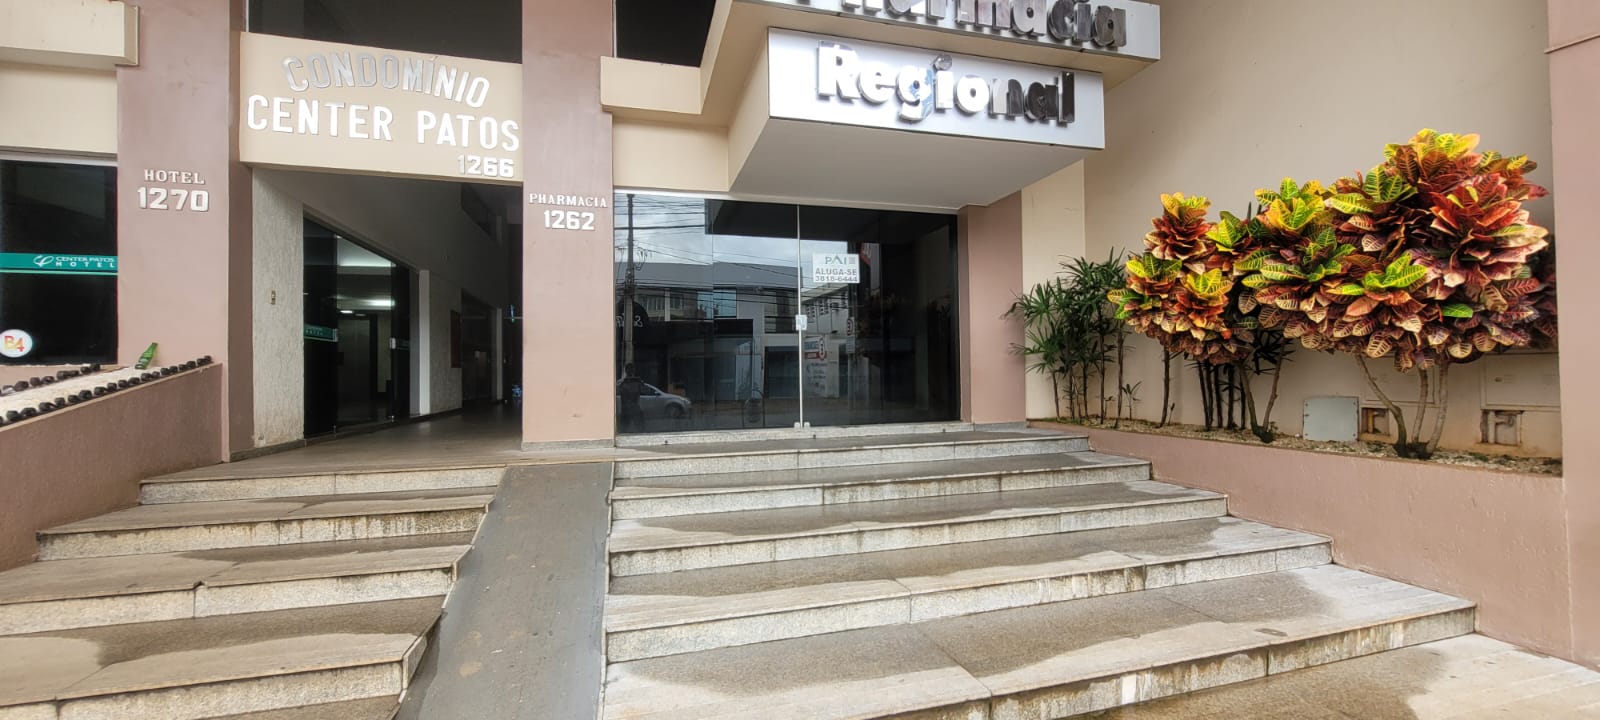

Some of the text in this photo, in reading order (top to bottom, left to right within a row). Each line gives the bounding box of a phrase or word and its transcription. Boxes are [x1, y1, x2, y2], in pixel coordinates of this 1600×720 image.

[283, 51, 490, 108] CONDOMÍNIO
[817, 41, 1076, 123] Regional
[247, 94, 520, 152] CENTER PATOS
[143, 168, 206, 185] HOTEL
[457, 154, 515, 178] 1266
[137, 186, 209, 212] 1270
[529, 192, 609, 209] PHARMACIA
[543, 208, 596, 231] 1262
[815, 267, 857, 275] ALUGA-SE
[4, 335, 25, 352] B4
